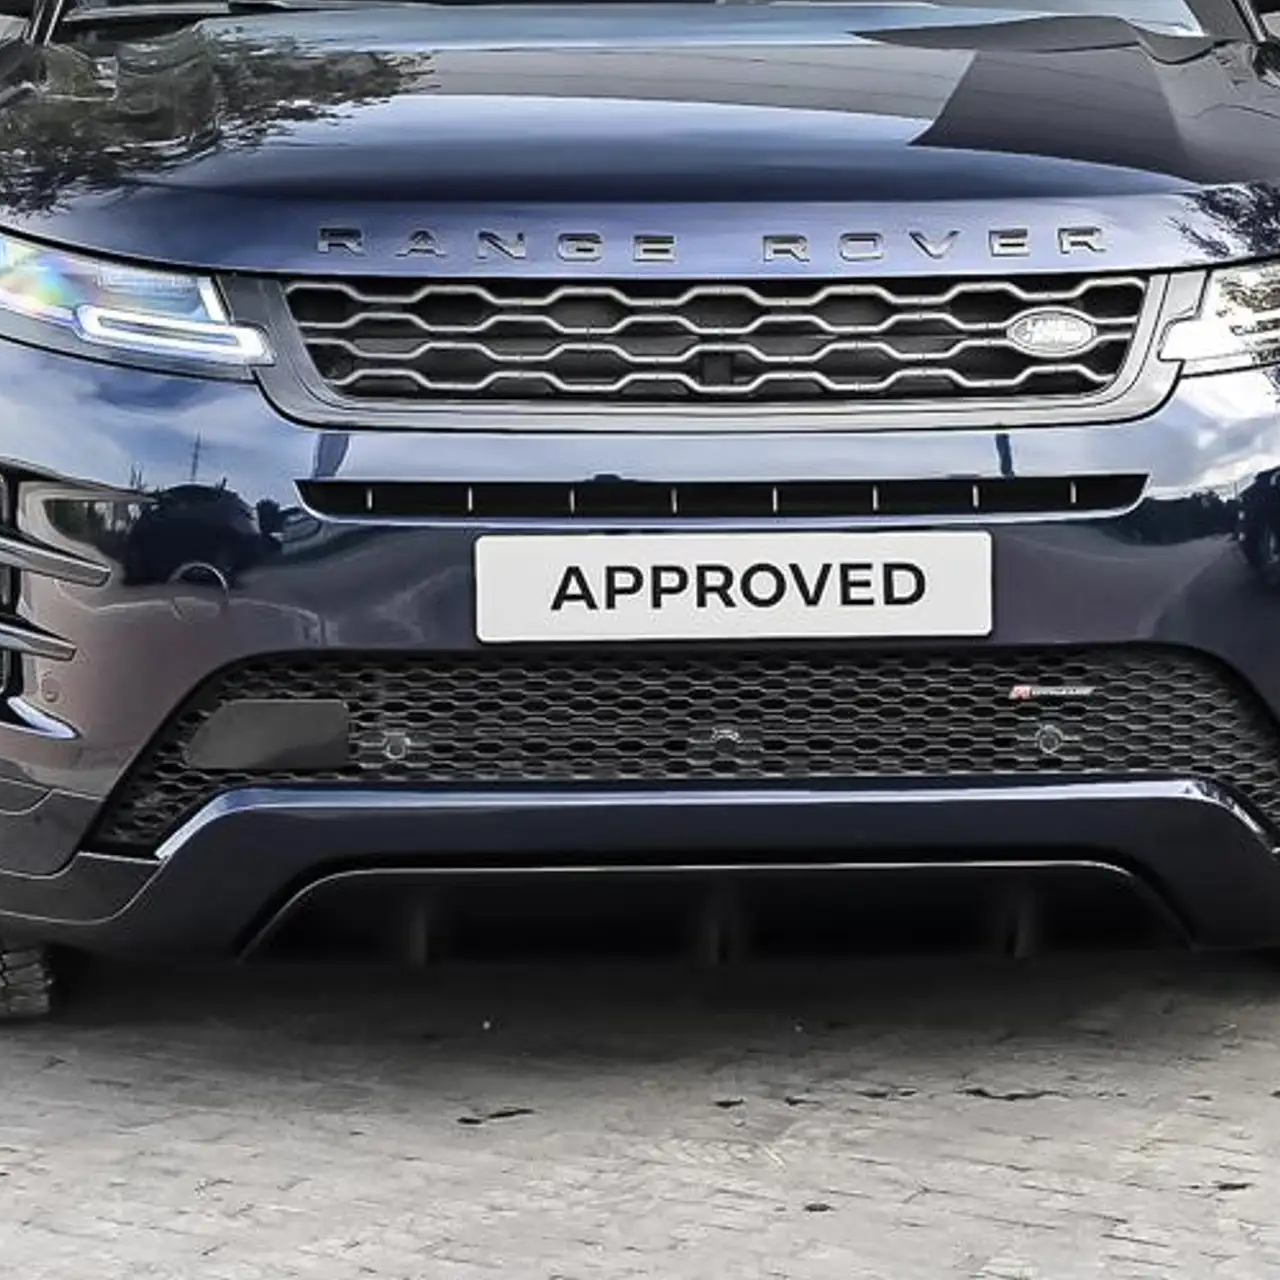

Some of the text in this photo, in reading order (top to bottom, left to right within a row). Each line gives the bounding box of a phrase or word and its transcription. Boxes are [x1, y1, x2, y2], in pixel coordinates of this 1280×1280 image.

[317, 226, 1107, 262] RANGE ROVER
[550, 561, 928, 611] APPROVED
